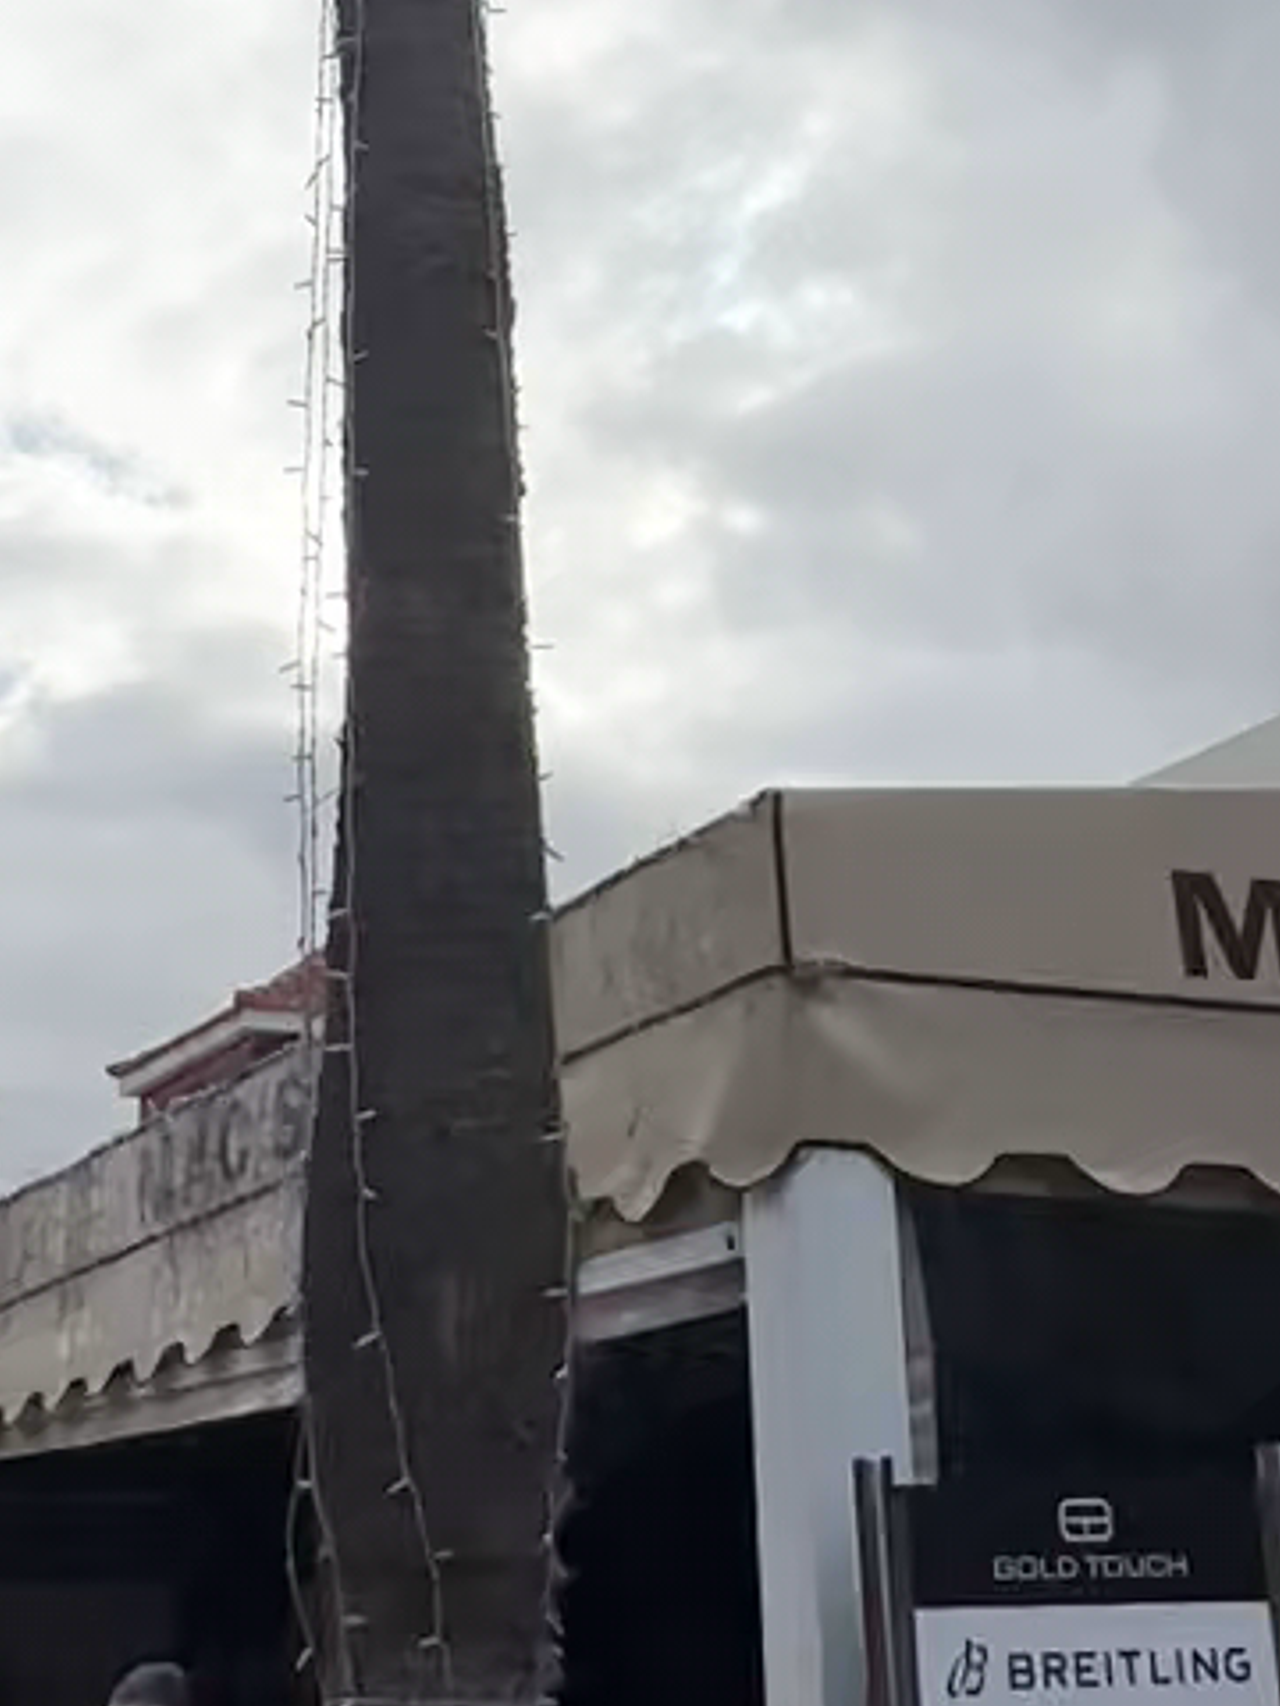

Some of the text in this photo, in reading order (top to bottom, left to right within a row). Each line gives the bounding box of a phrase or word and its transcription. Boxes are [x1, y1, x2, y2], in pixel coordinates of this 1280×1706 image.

[992, 1552, 1190, 1582] GOLD TOUCH
[1006, 1646, 1253, 1692] BREITLING
